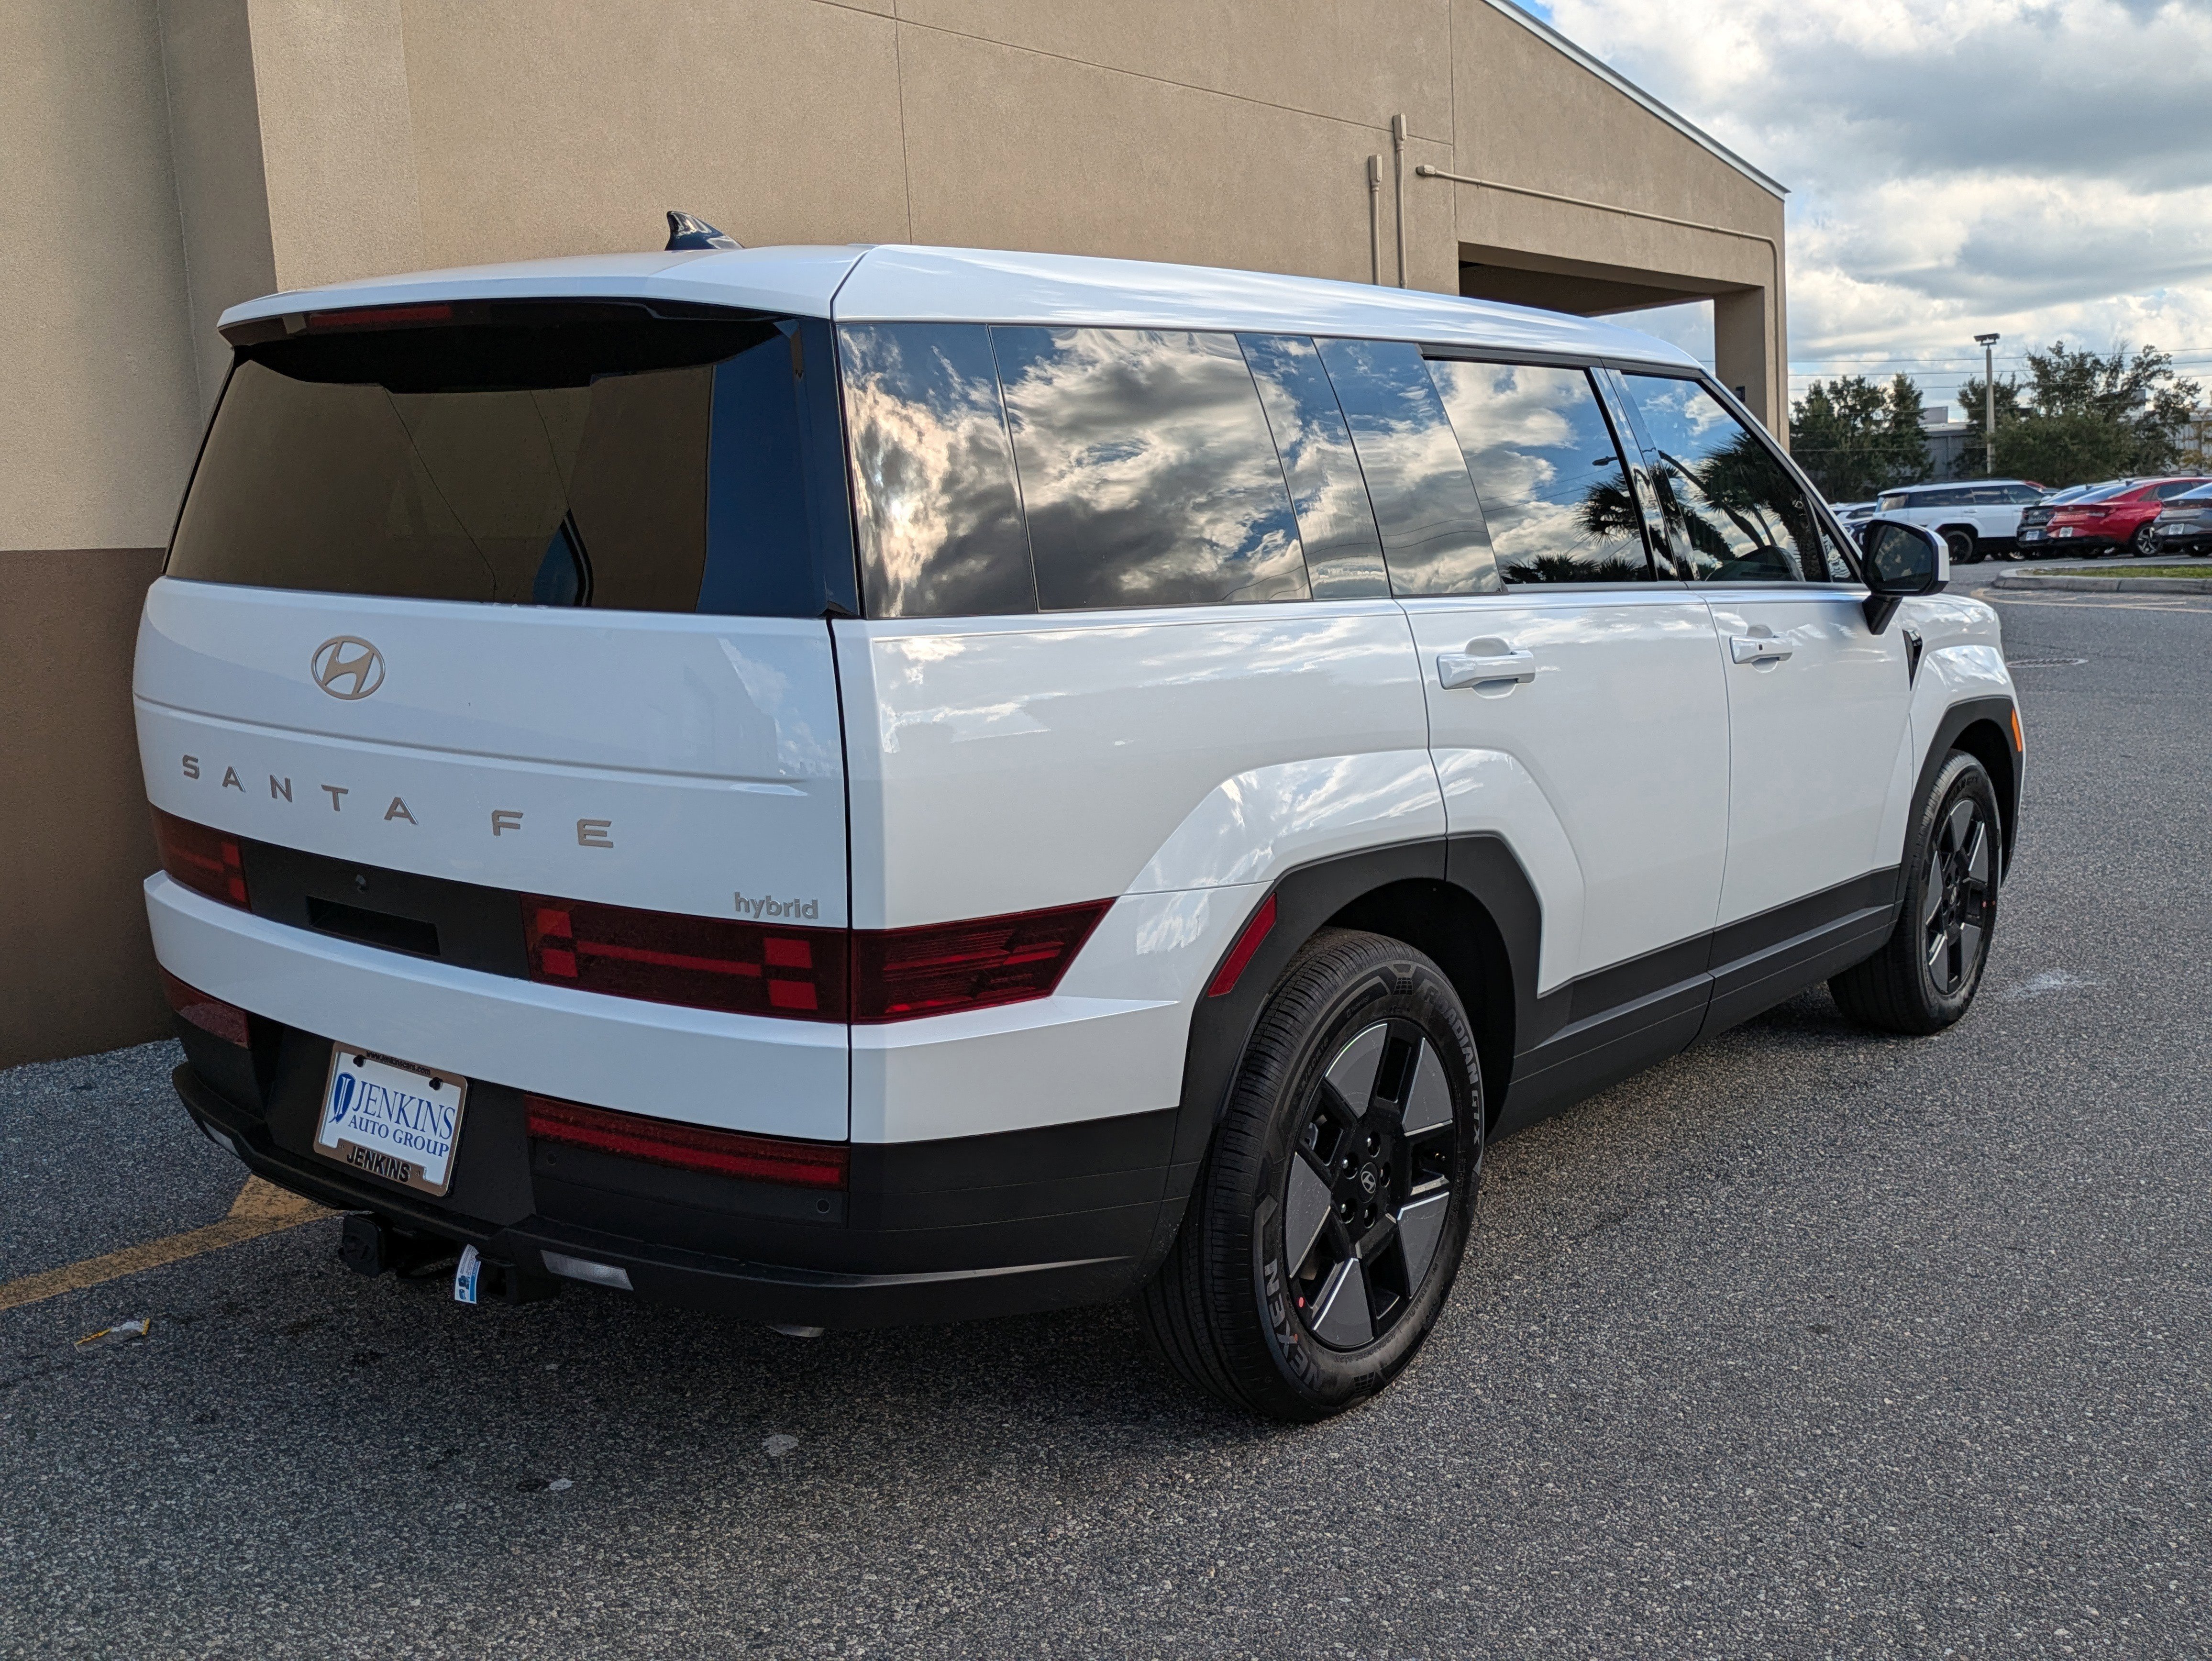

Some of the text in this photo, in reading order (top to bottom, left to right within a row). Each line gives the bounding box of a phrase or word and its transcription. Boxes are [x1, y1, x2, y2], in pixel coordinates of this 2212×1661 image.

[181, 754, 614, 849] SANTA FE
[734, 891, 819, 919] hybrid
[366, 1051, 431, 1075] www.jenkinscars.com
[352, 1080, 455, 1140] JENKINS
[348, 1115, 449, 1158] AUTO GROUP
[347, 1145, 411, 1183] JENKINS
[1264, 1258, 1324, 1391] NEXEN
